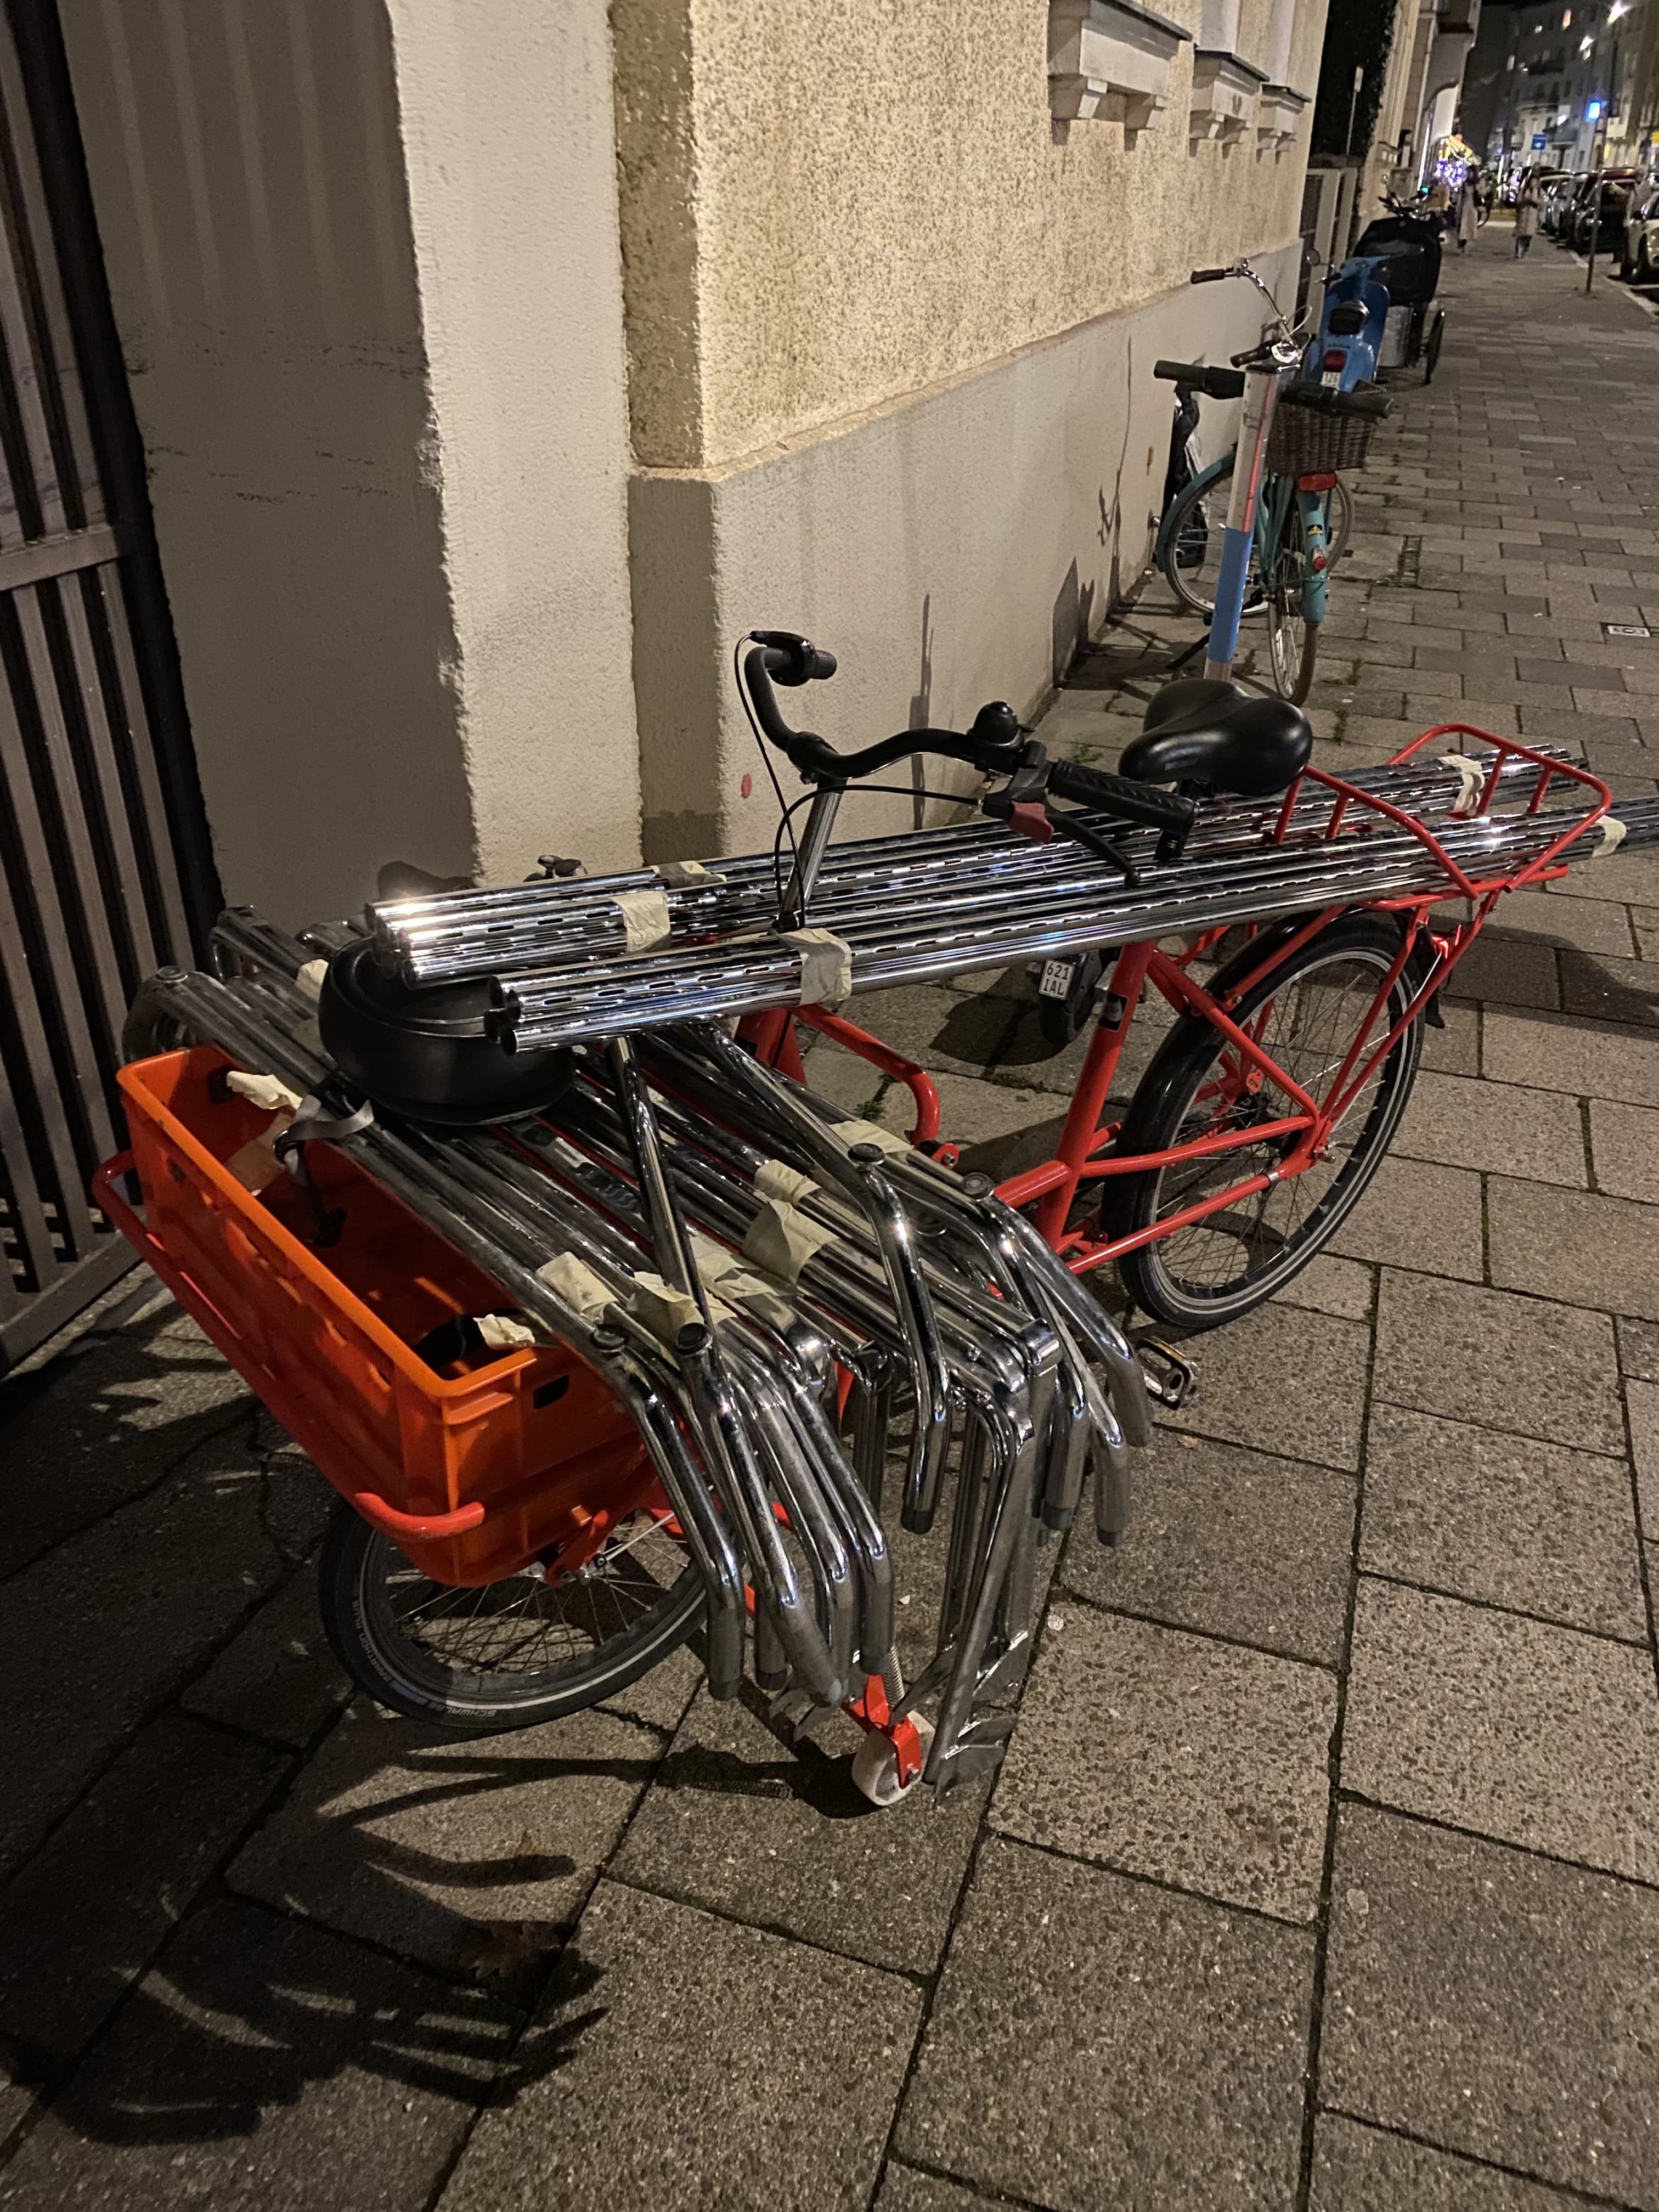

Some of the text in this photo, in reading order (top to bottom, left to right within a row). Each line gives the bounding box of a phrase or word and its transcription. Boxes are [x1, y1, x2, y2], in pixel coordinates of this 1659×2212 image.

[1324, 374, 1339, 383] 126
[1047, 963, 1069, 980] 621
[1043, 978, 1064, 996] IAL
[352, 1599, 392, 1682] MARATHON PLUS
[426, 1701, 497, 1718] SCHWALBE
